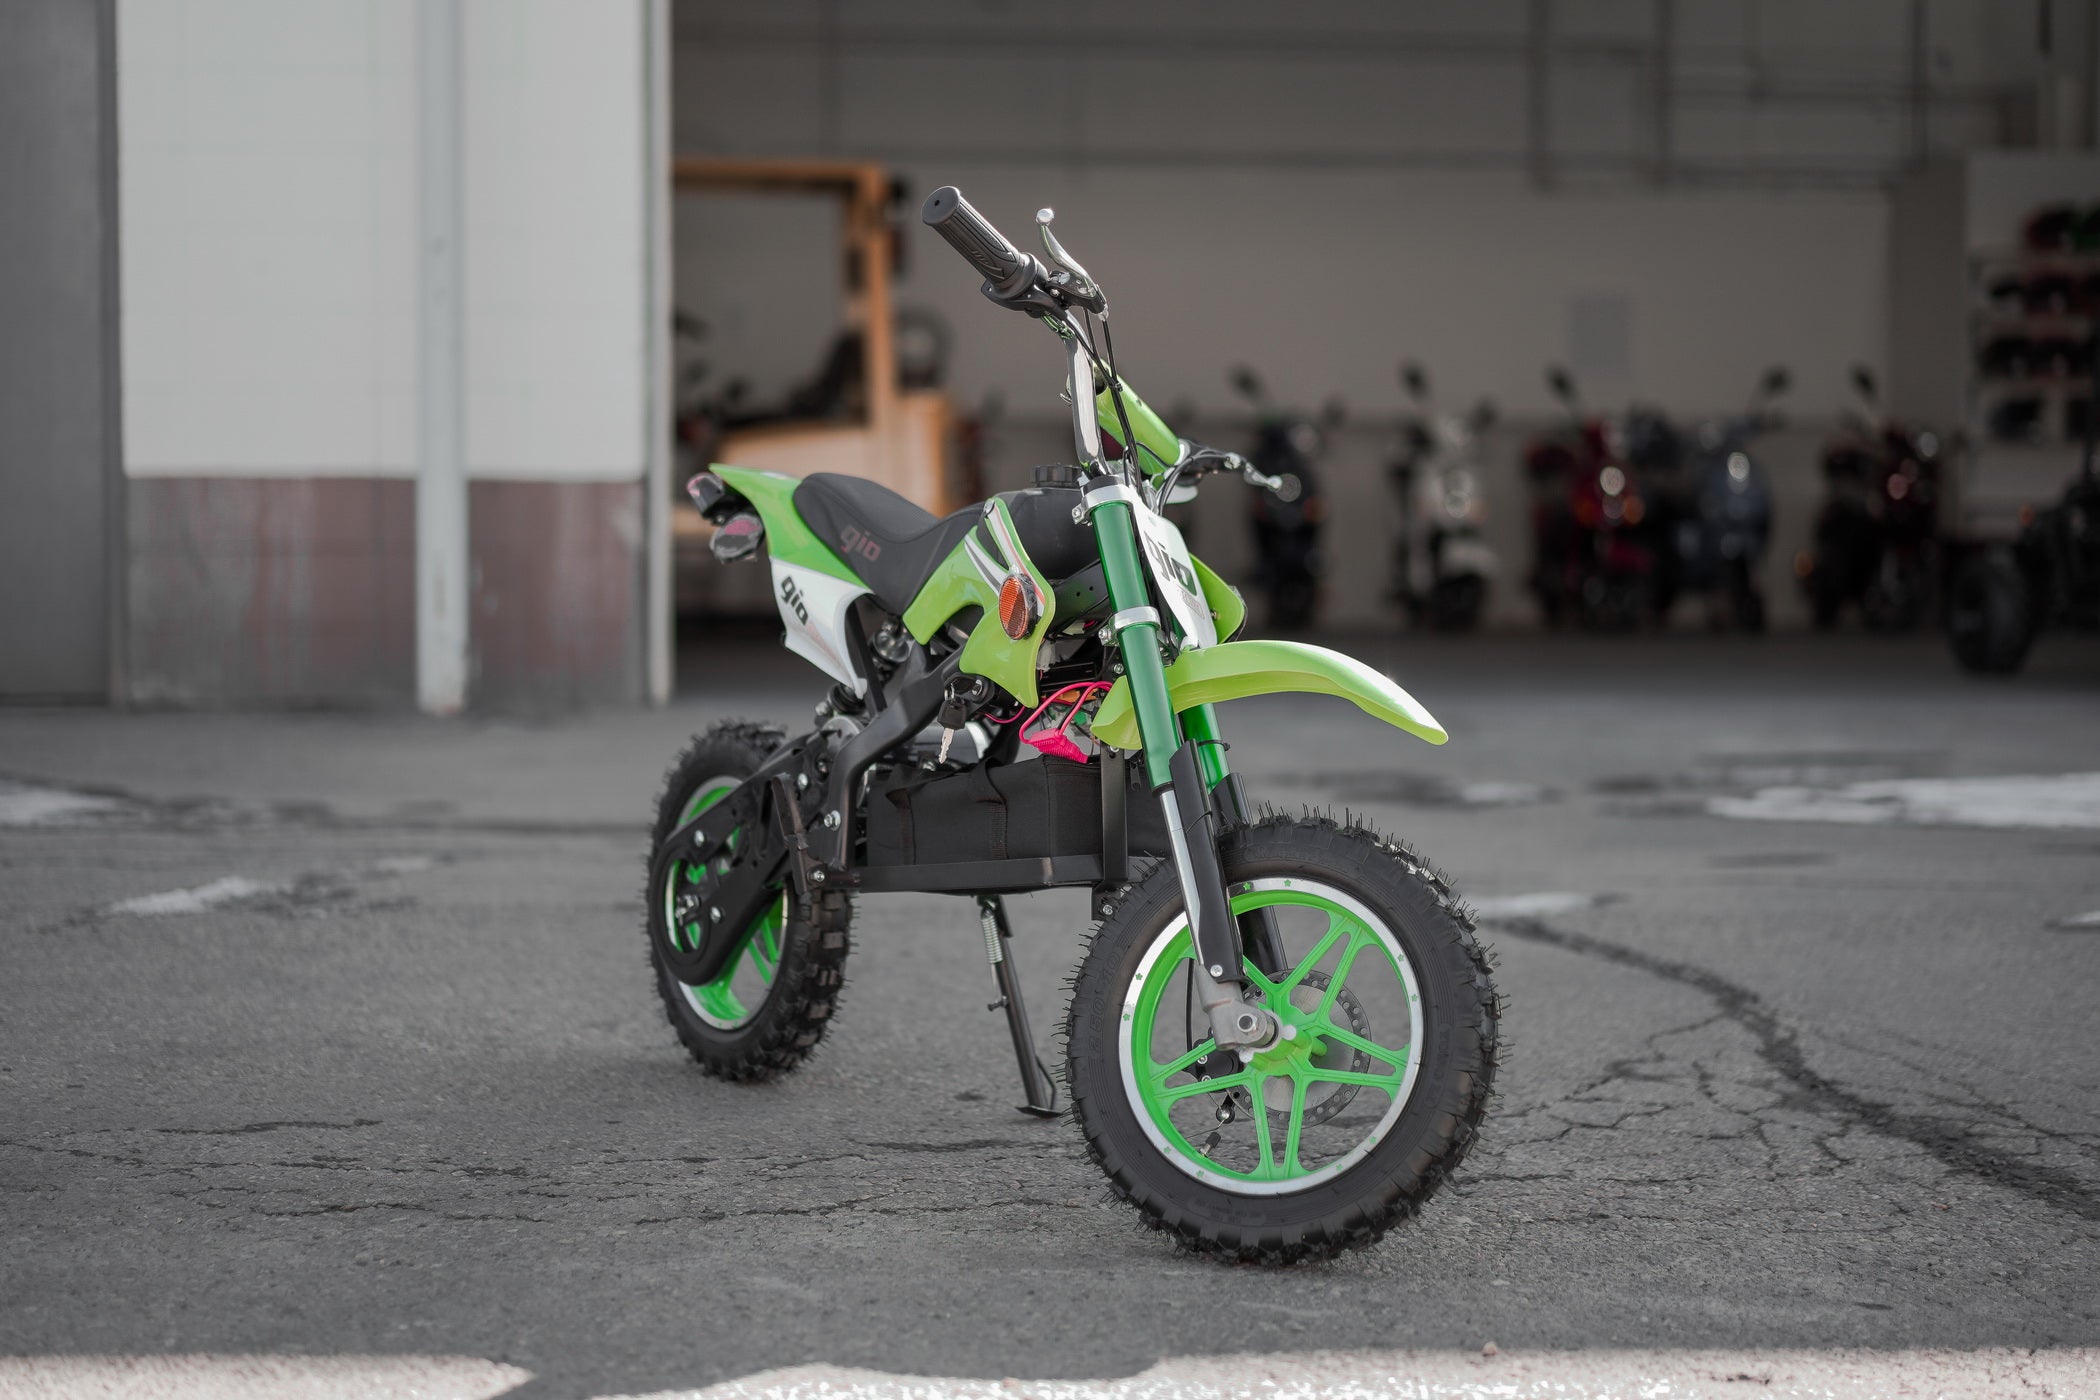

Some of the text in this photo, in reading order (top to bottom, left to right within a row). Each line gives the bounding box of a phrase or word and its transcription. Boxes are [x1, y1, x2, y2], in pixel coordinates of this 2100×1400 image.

[841, 525, 881, 562] gio
[1143, 530, 1197, 597] gio
[780, 576, 809, 626] gio
